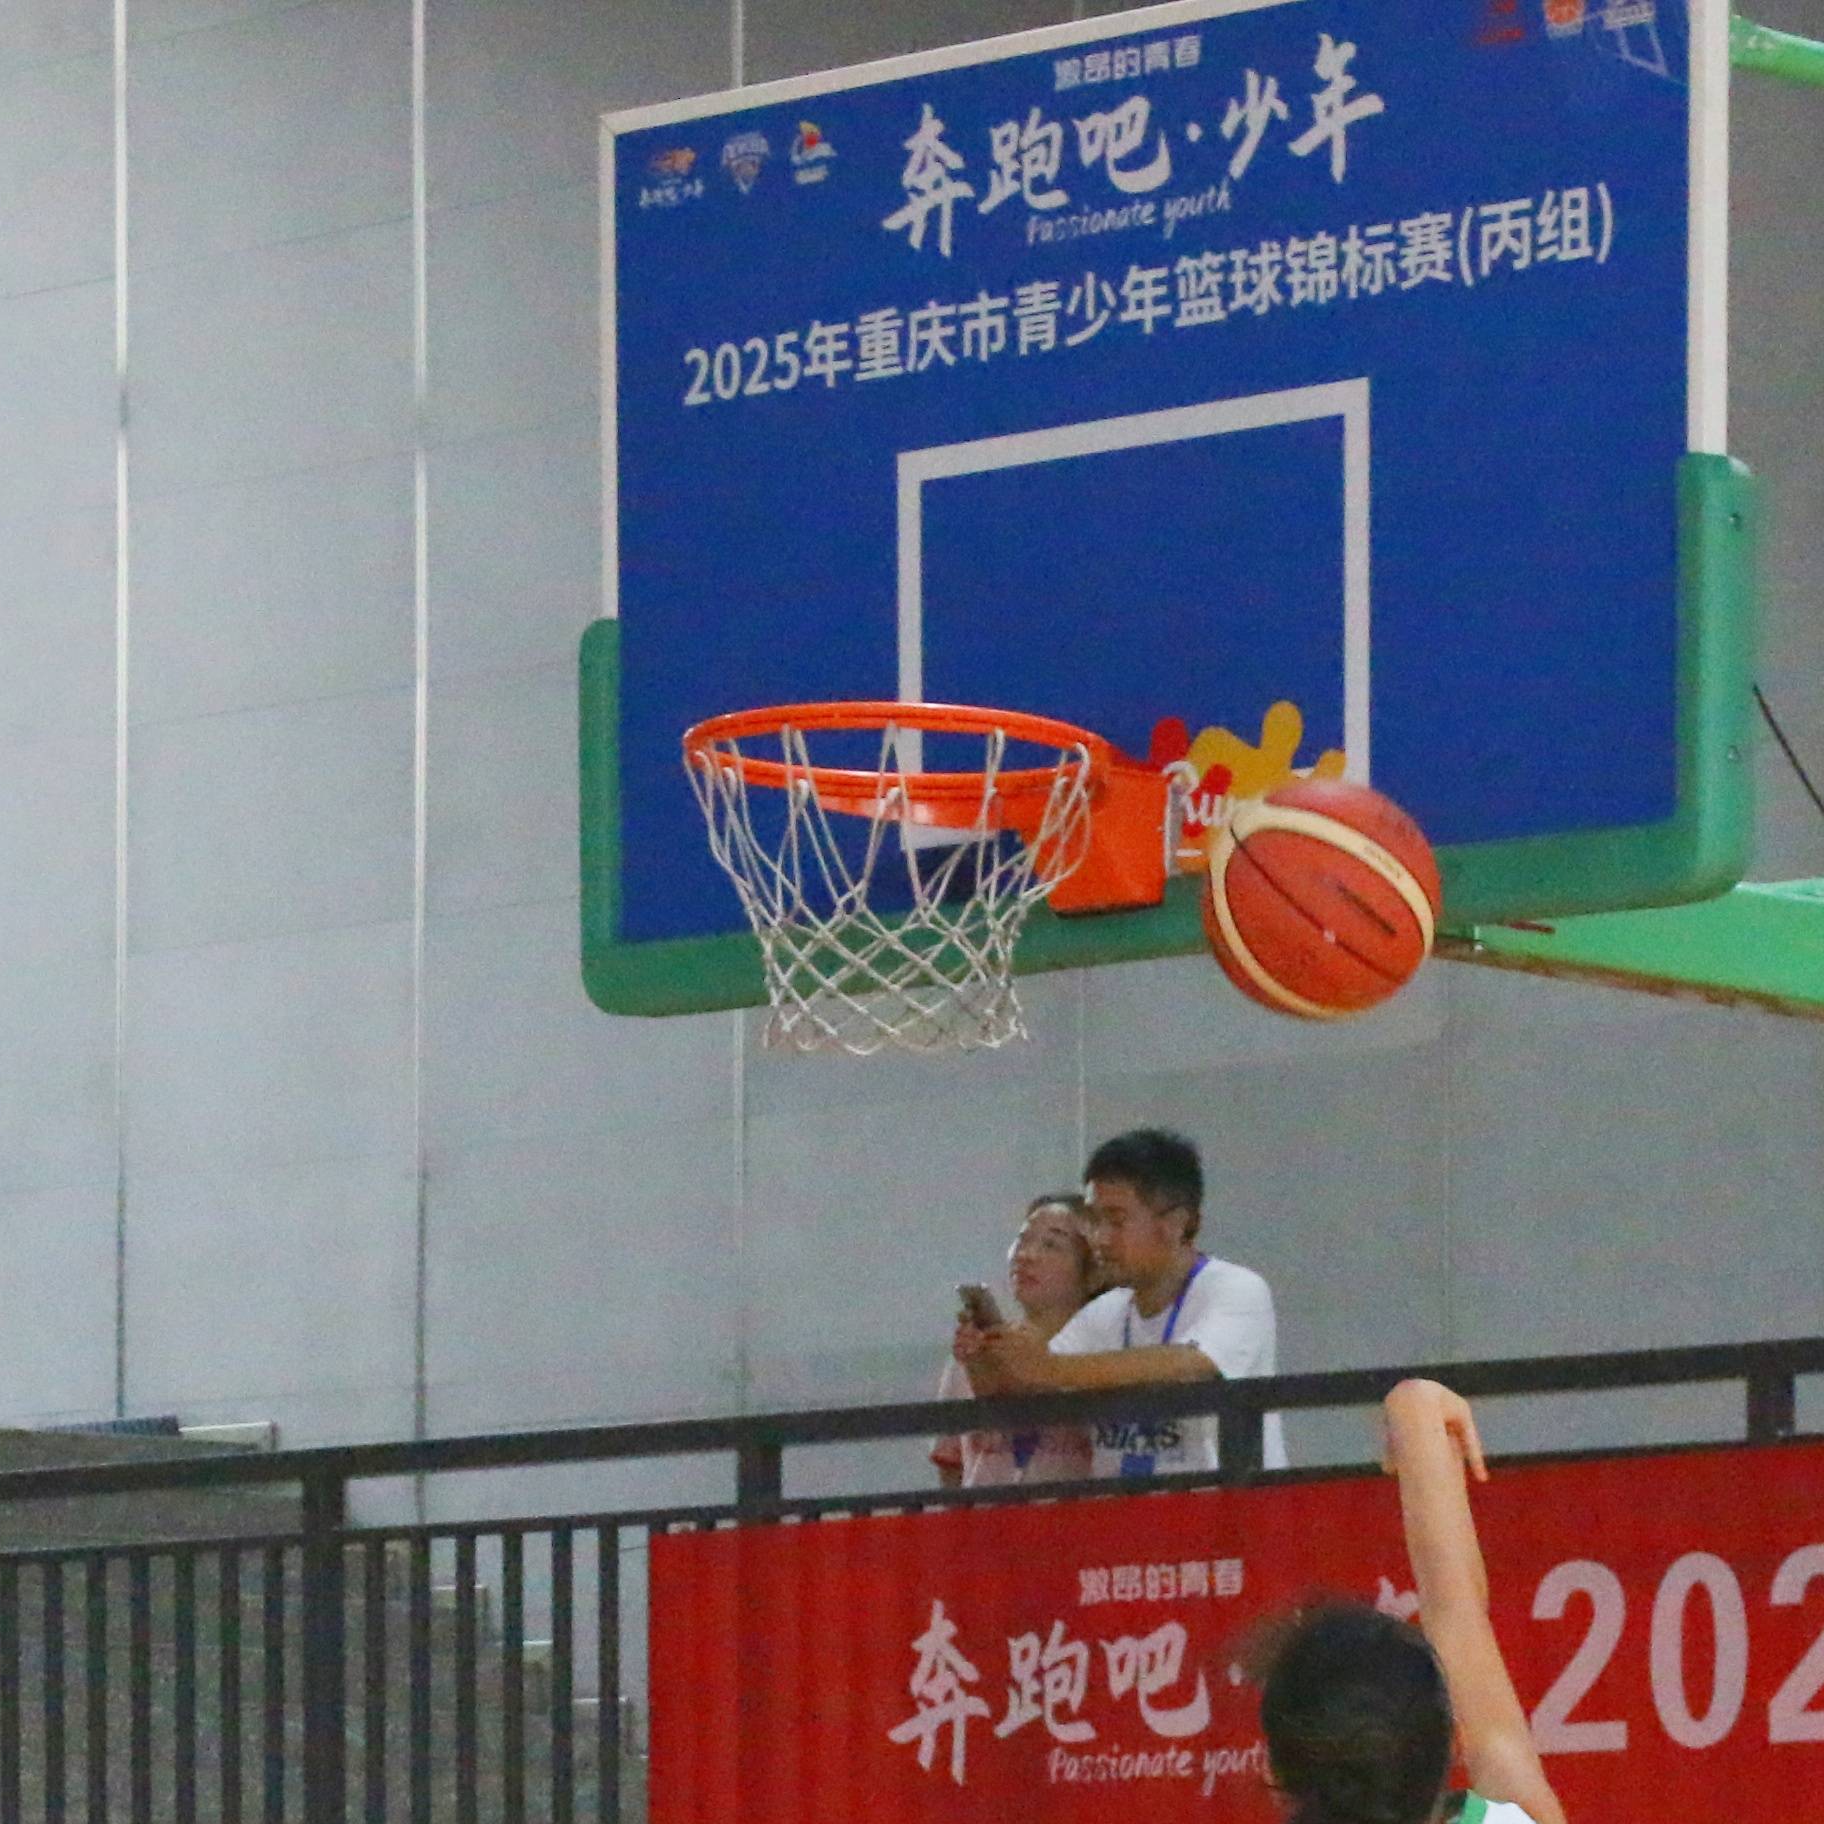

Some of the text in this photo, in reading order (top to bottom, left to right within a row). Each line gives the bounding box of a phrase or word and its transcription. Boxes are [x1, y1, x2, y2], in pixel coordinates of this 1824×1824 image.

[1026, 178, 1233, 245] Passionate youth
[682, 184, 1616, 407] 2025年重庆市青少年篮球锦标赛(丙组)
[1048, 1743, 1194, 1785] Passionate
